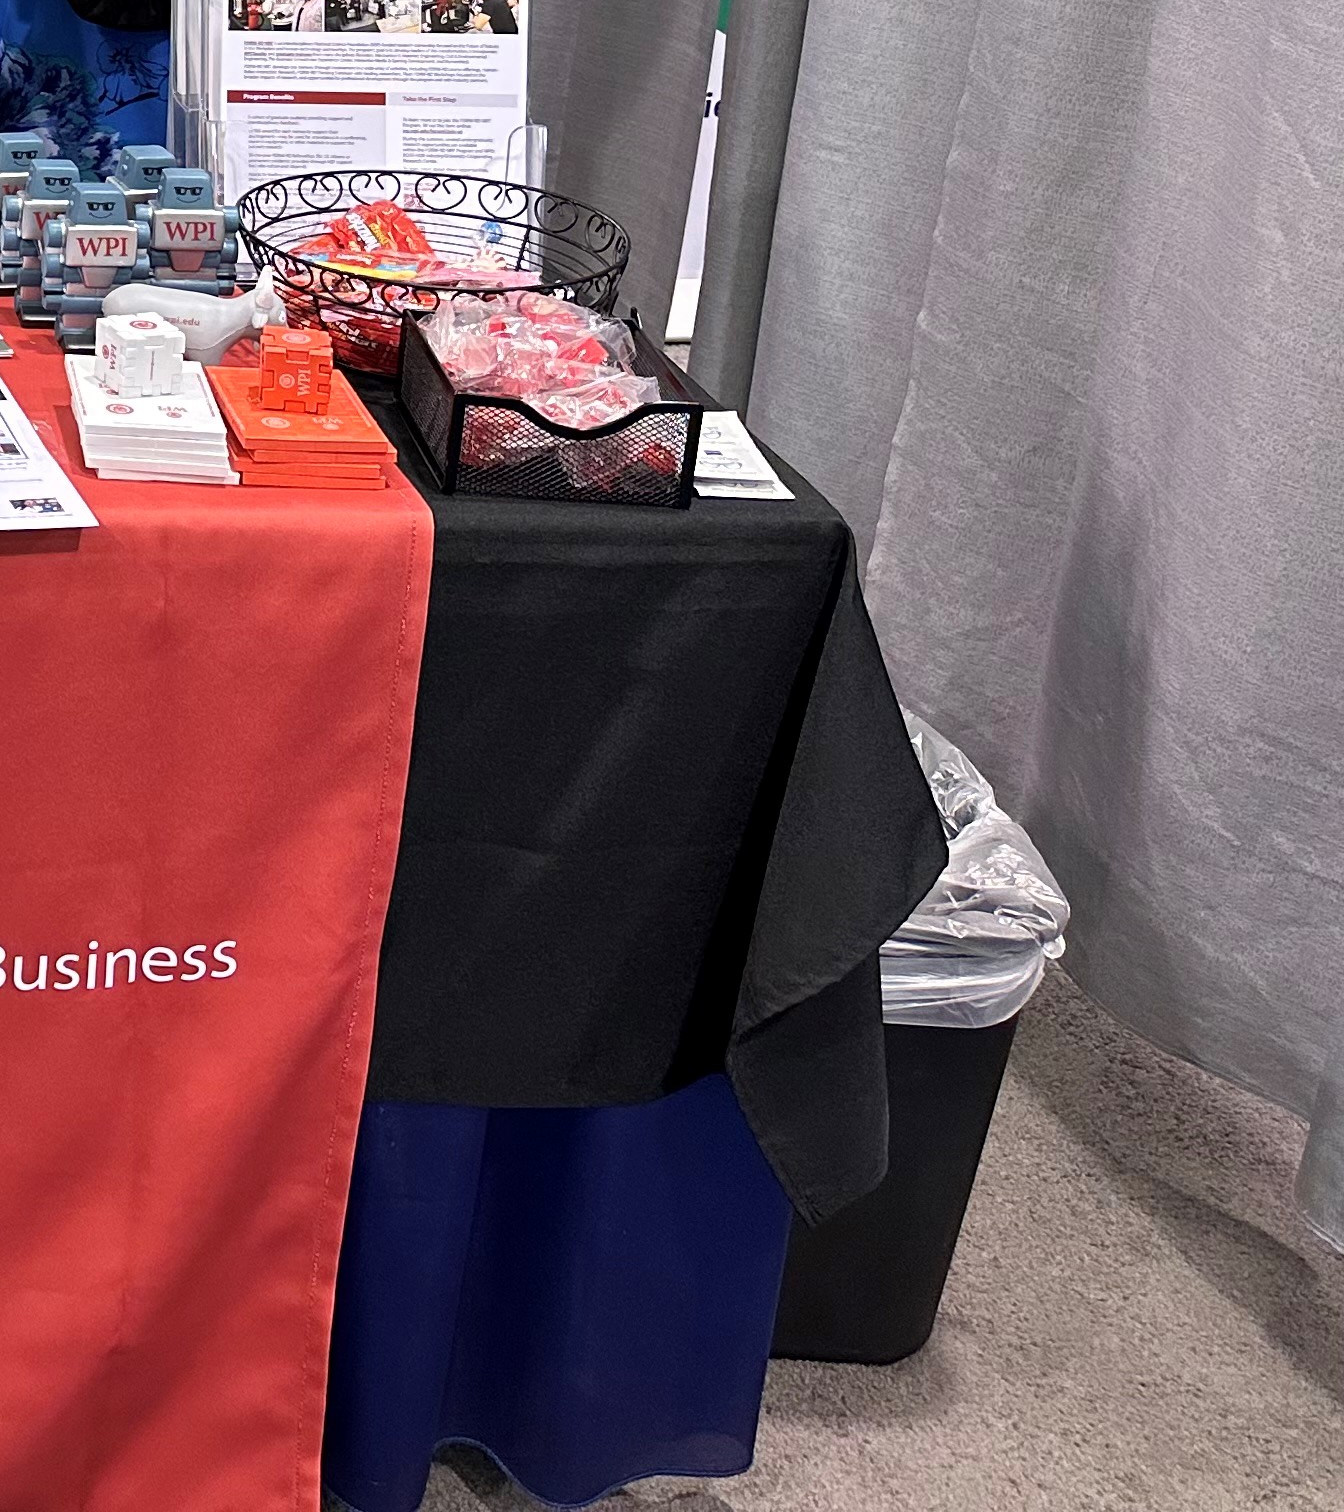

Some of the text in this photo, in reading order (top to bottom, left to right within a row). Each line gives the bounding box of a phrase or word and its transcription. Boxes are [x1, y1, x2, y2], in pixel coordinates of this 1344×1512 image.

[162, 221, 217, 242] WPI
[76, 237, 128, 258] WPI
[296, 368, 312, 397] WPI
